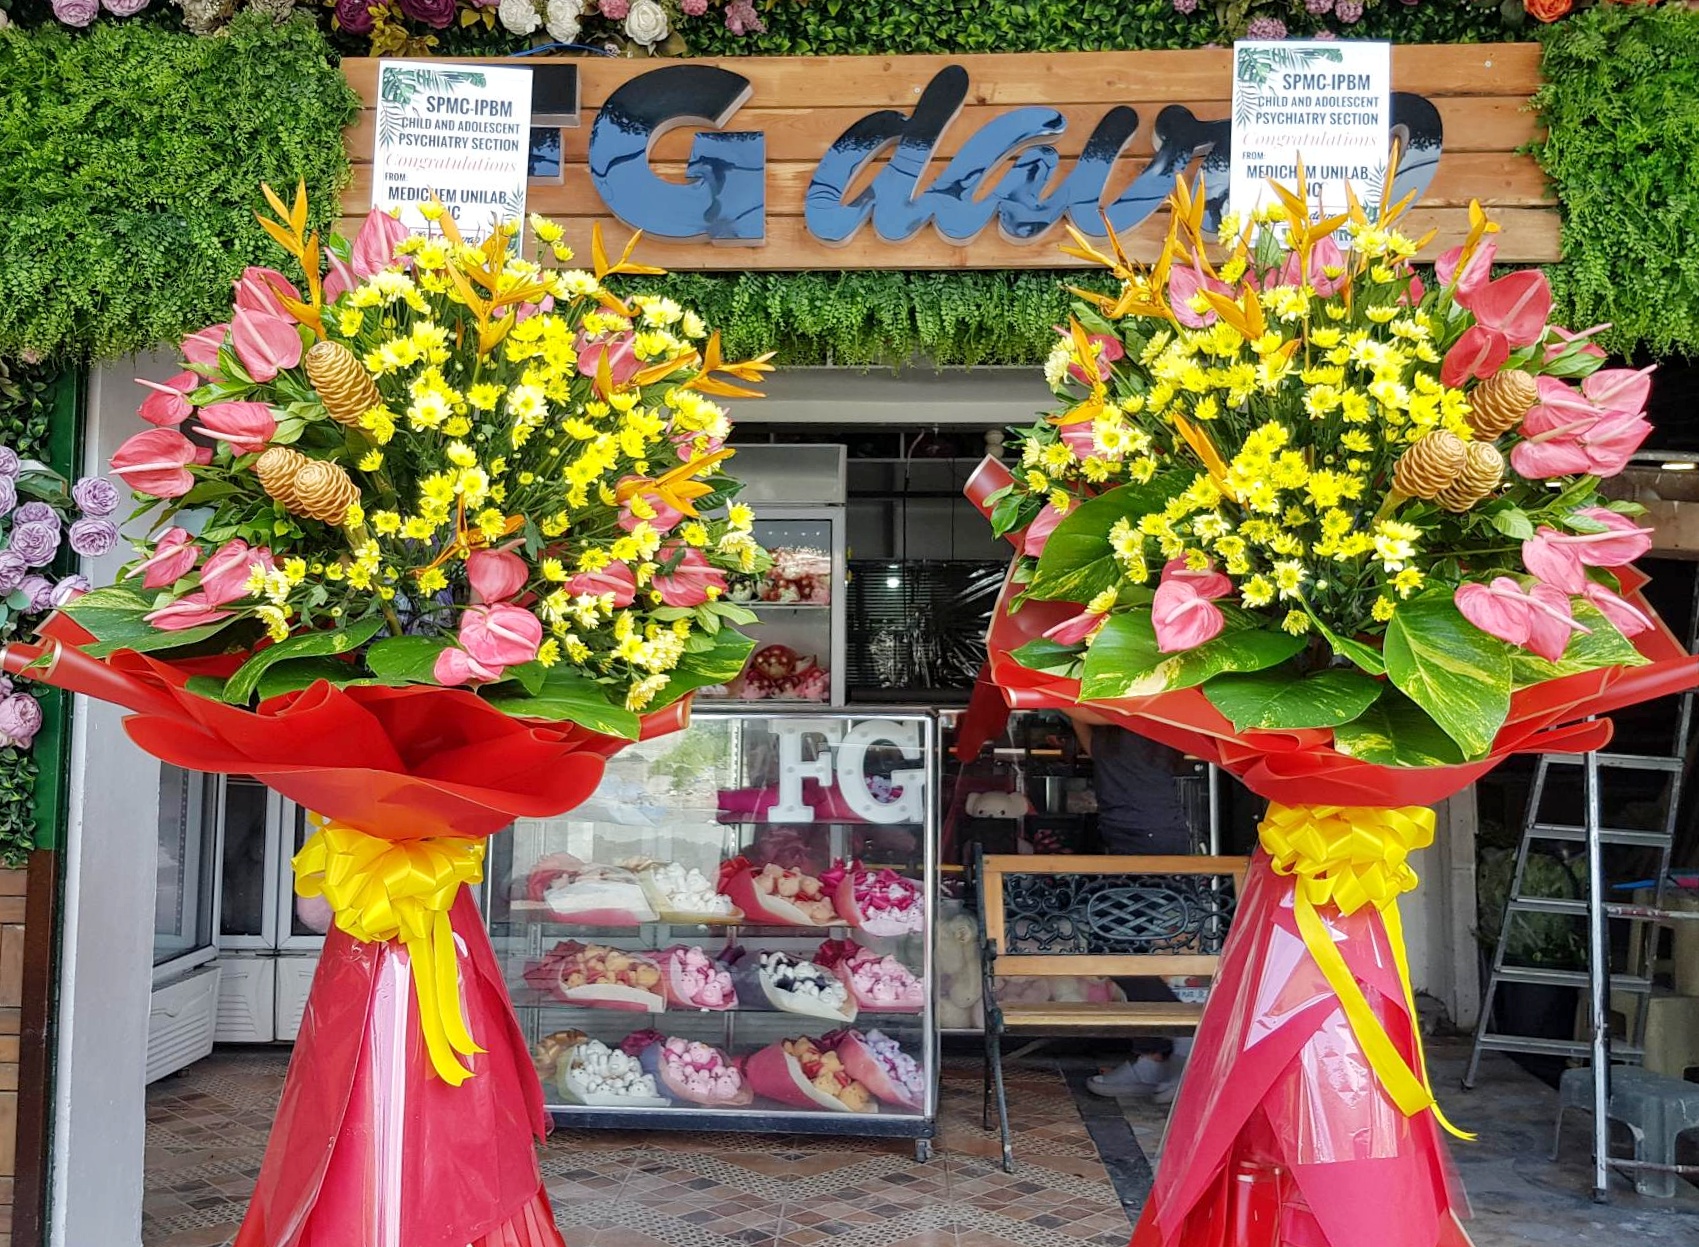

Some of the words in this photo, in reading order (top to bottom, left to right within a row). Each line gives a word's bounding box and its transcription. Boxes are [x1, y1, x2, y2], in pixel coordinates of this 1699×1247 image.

[1282, 73, 1371, 91] SPMC-IPBM
[426, 95, 513, 118] SPMC-IPBM
[1258, 95, 1288, 108] CHILD
[1291, 96, 1312, 108] AND
[1315, 96, 1379, 108] ADOLESCENT
[401, 116, 432, 130] CHILD
[434, 118, 455, 131] AND
[458, 120, 520, 135] ADOLESCENT
[1255, 112, 1327, 125] PSYCHIATRY
[1329, 112, 1379, 125] SECTION
[398, 132, 469, 149] PSYCHIATRY
[471, 137, 519, 152] SECTION
[1242, 131, 1377, 148] Congratulations
[386, 152, 516, 173] Congratulations
[1246, 164, 1317, 179] MEDICHM
[767, 718, 925, 824] FG
